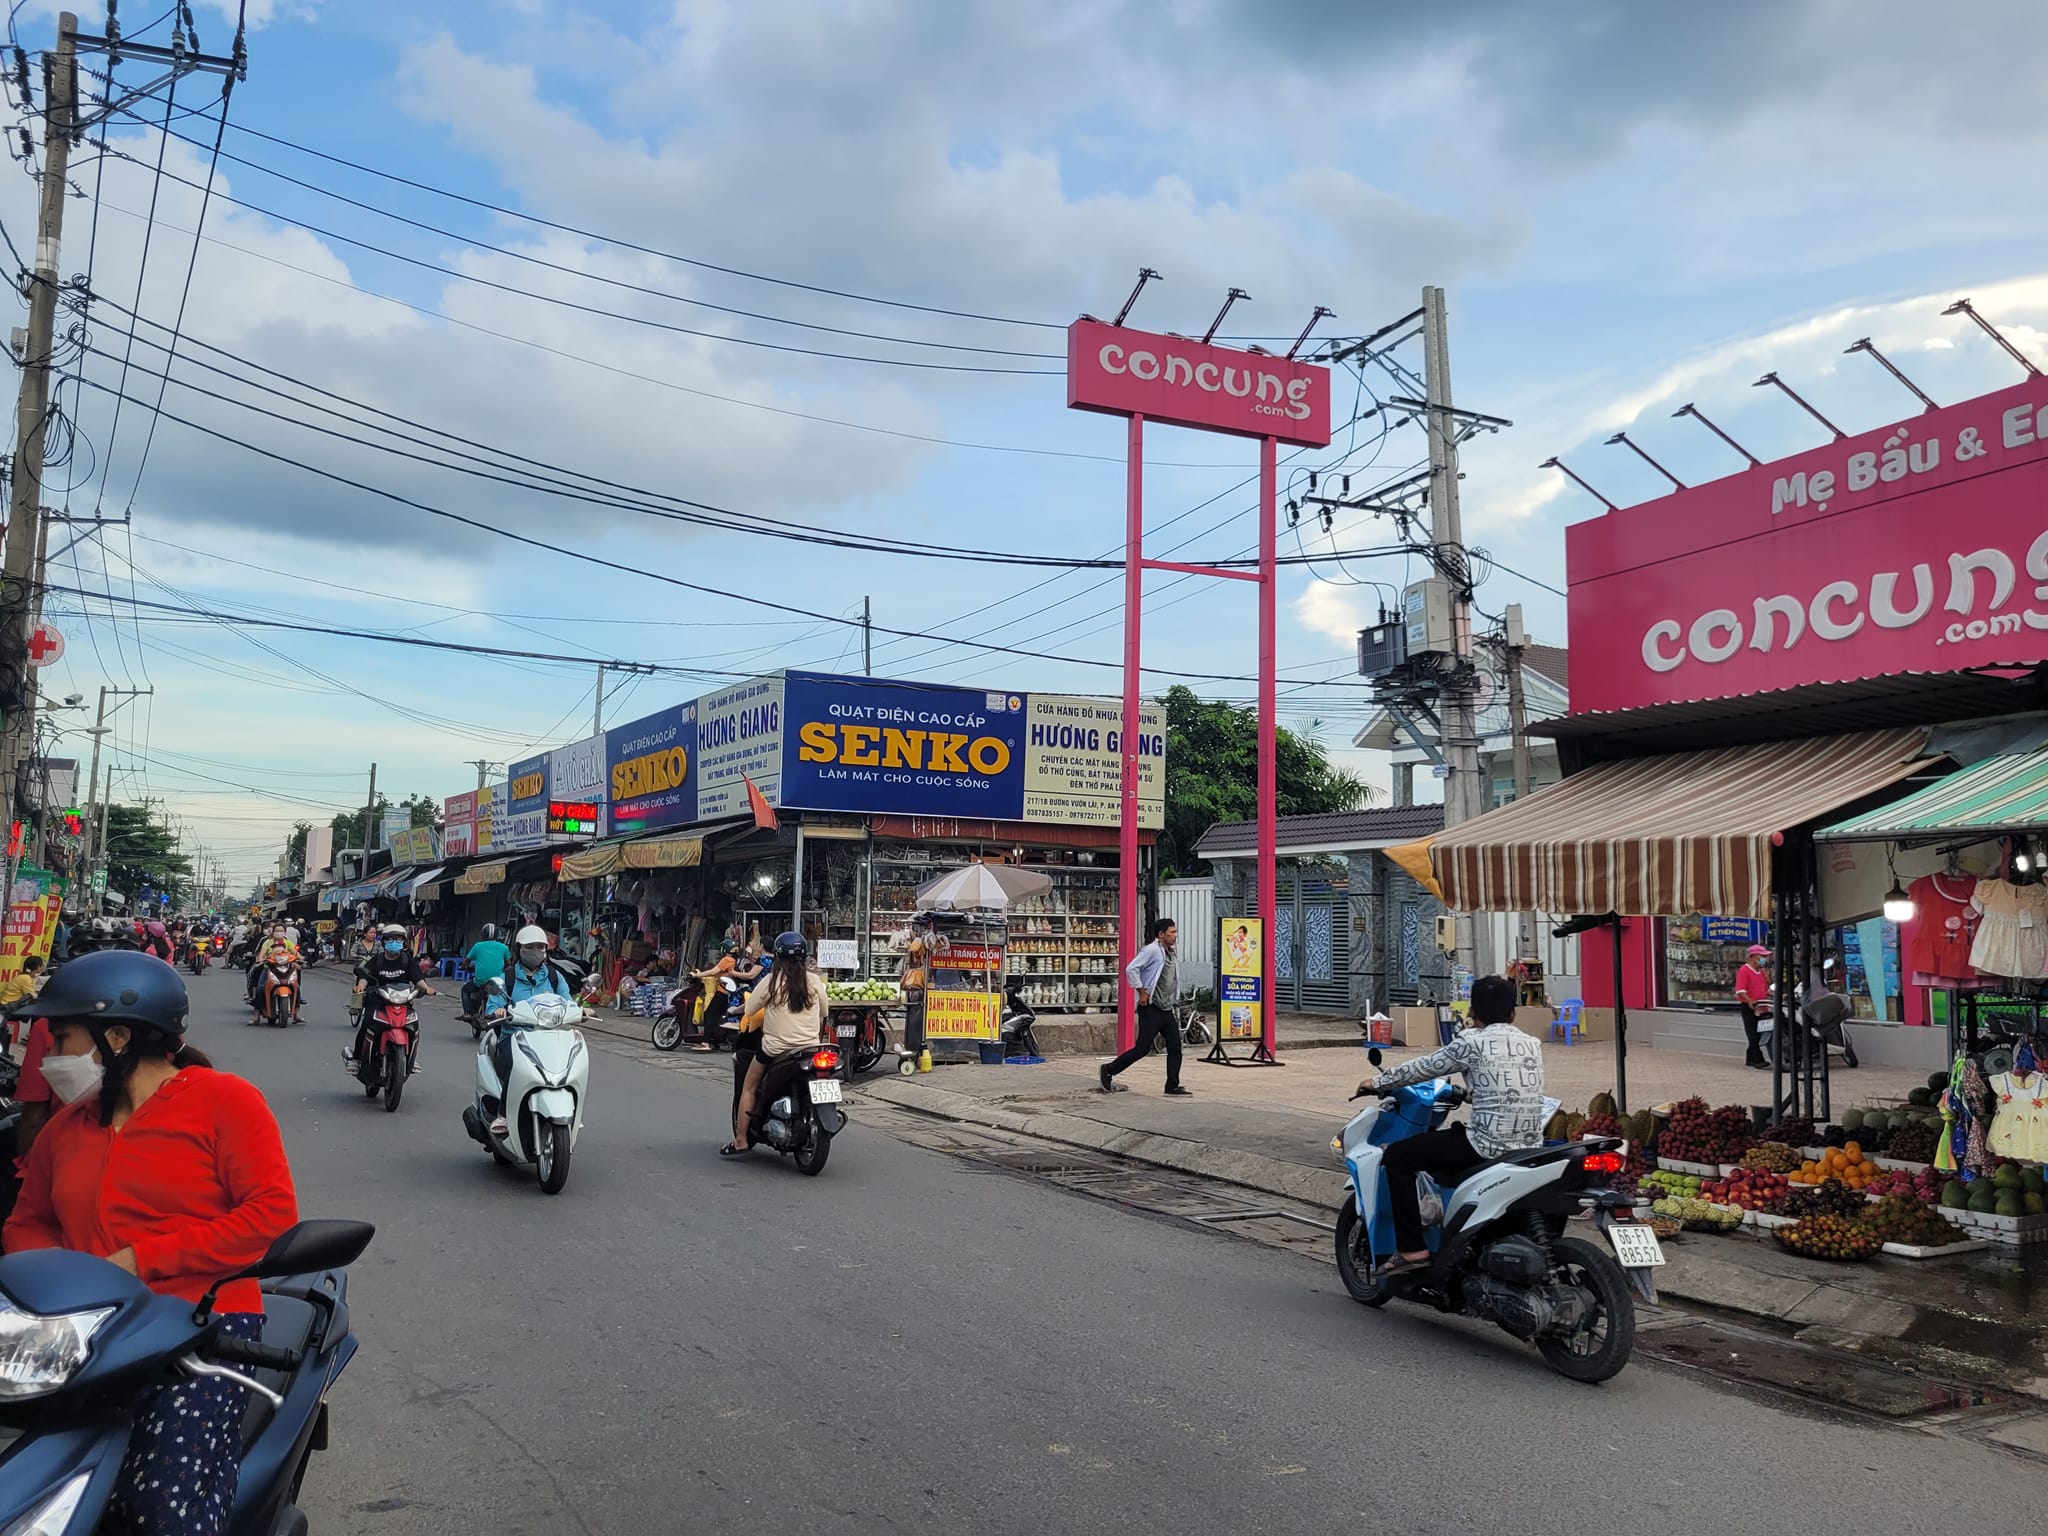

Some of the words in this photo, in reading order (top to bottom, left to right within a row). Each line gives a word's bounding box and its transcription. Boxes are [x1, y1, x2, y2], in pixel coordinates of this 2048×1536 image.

[1099, 344, 1312, 420] concung
[1772, 471, 1835, 514] Mẹ
[1847, 427, 1940, 492] Bầu
[1955, 427, 1988, 461] &
[1935, 612, 2022, 646] .com
[699, 714, 736, 751] HƯƠNG
[740, 701, 779, 740] GIANG
[829, 704, 874, 720] QUẠT
[876, 706, 915, 724] ĐIỆN
[918, 711, 951, 725] CAO
[954, 712, 986, 728] CẤP
[1057, 704, 1079, 717] HÀNG
[1096, 709, 1118, 722] NHỰA
[800, 722, 1010, 775] SENKO
[1031, 722, 1099, 751] HƯƠNG
[512, 772, 544, 801] SENKO
[612, 746, 687, 801] SENKO
[819, 769, 847, 779] LÀM
[852, 770, 880, 781] MÁT
[883, 773, 912, 783] CHO
[916, 775, 952, 787] CUỘC
[955, 777, 990, 789] SỐNG
[20, 934, 35, 957] 2
[1617, 1228, 1650, 1245] 66-F1
